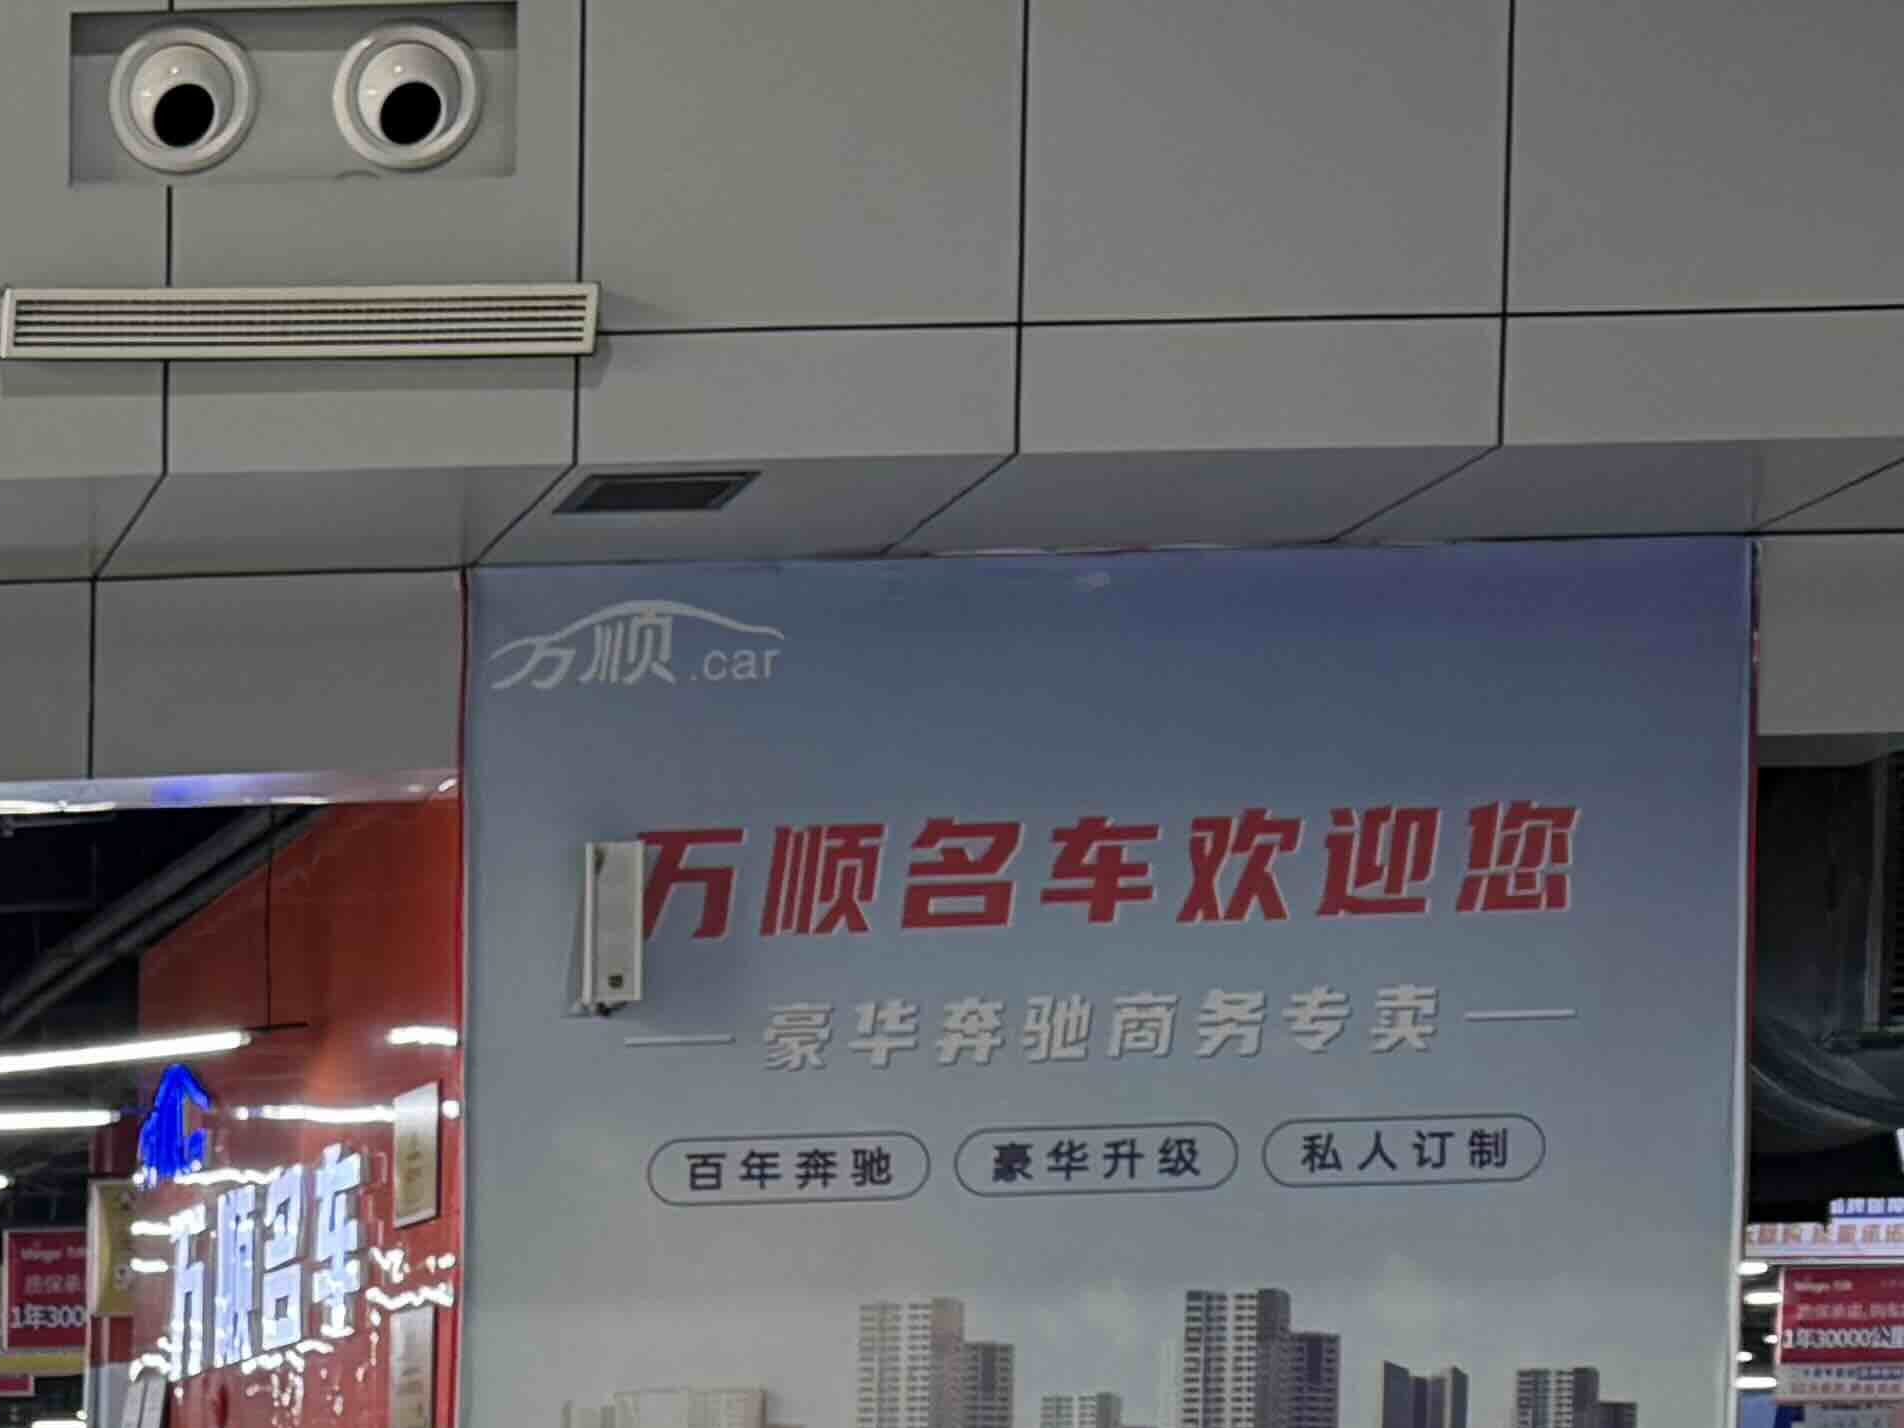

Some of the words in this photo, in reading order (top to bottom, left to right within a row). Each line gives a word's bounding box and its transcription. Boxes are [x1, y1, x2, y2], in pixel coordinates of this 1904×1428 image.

[635, 800, 1580, 943] 万顺名车欢迎您
[762, 984, 1442, 1071] 豪华奔驰商务专卖
[684, 1150, 894, 1191] 百年奔驰
[992, 1138, 1202, 1184] 豪华升级
[1301, 1130, 1511, 1174] 私人订制
[170, 1143, 366, 1382] 万顺名车
